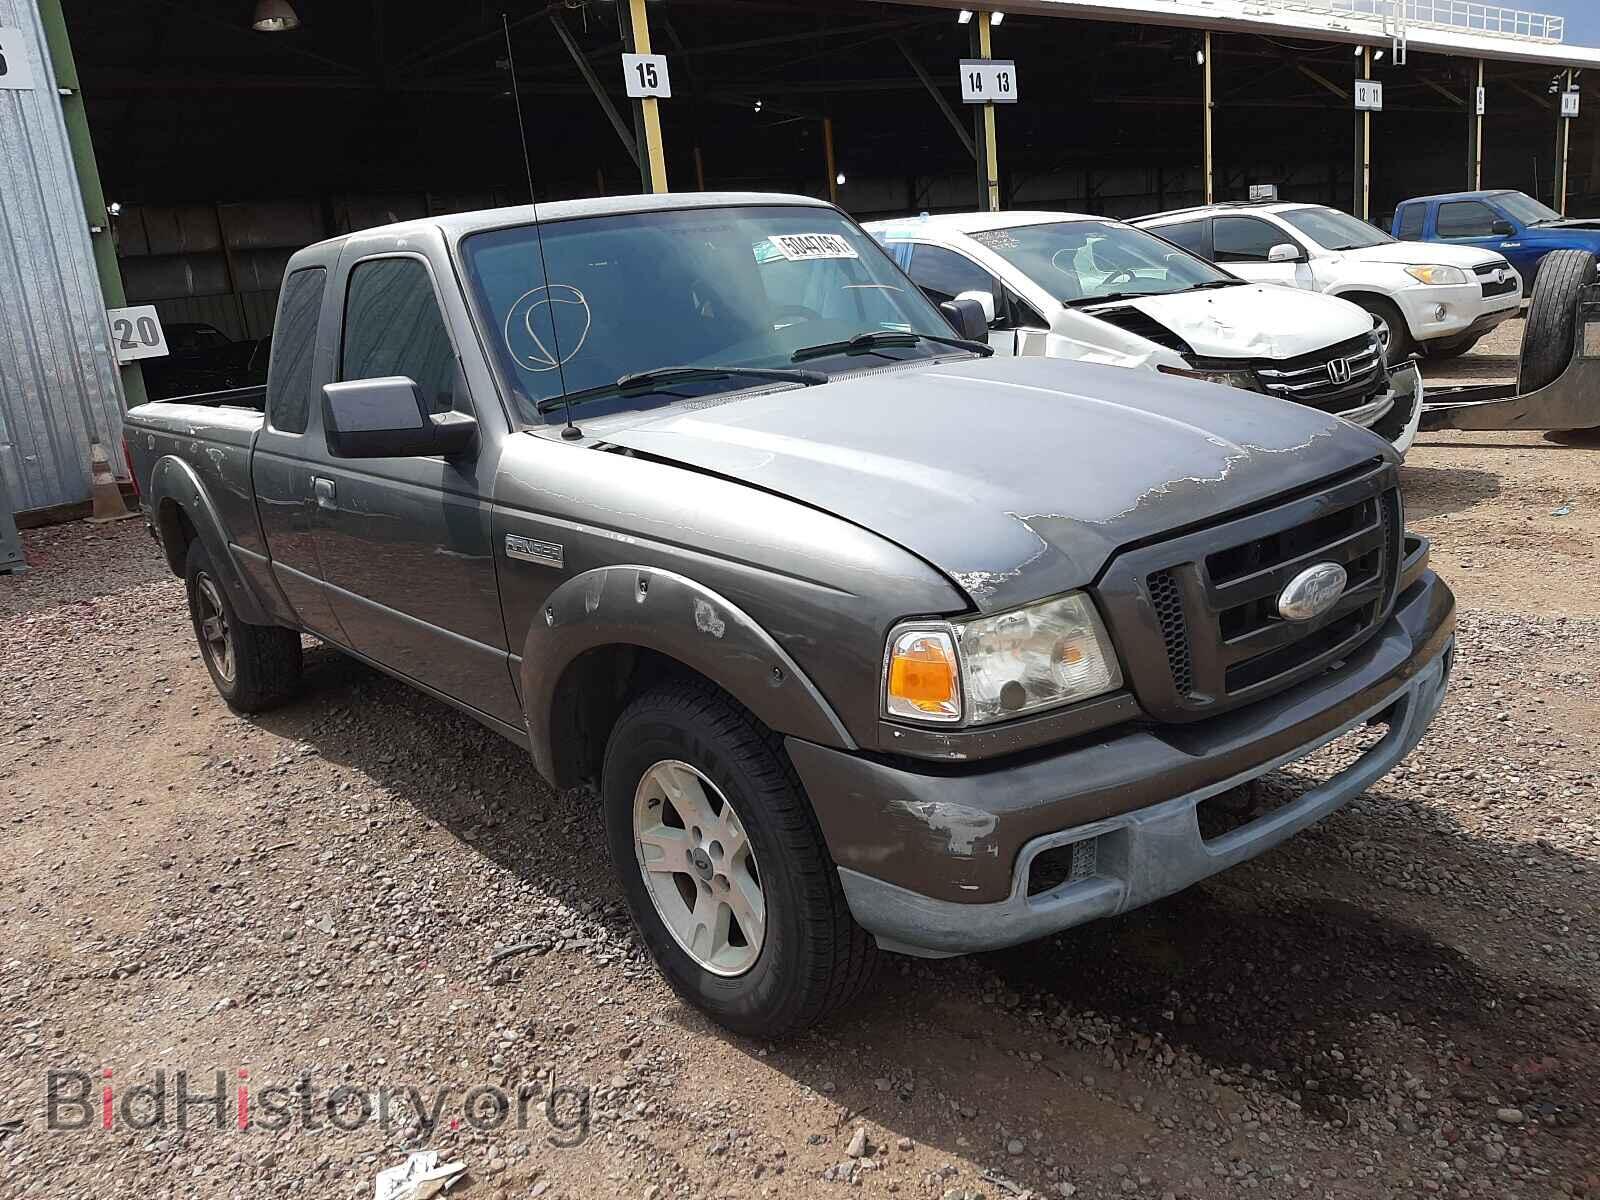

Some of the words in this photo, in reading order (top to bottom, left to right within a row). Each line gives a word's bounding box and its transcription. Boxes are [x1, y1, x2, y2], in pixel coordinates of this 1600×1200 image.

[636, 63, 658, 88] 15
[969, 72, 982, 92] 14
[997, 72, 1010, 92] 13
[1359, 88, 1366, 102] 12
[1372, 88, 1379, 102] 11
[780, 236, 846, 255] 50447461
[114, 317, 160, 349] 20
